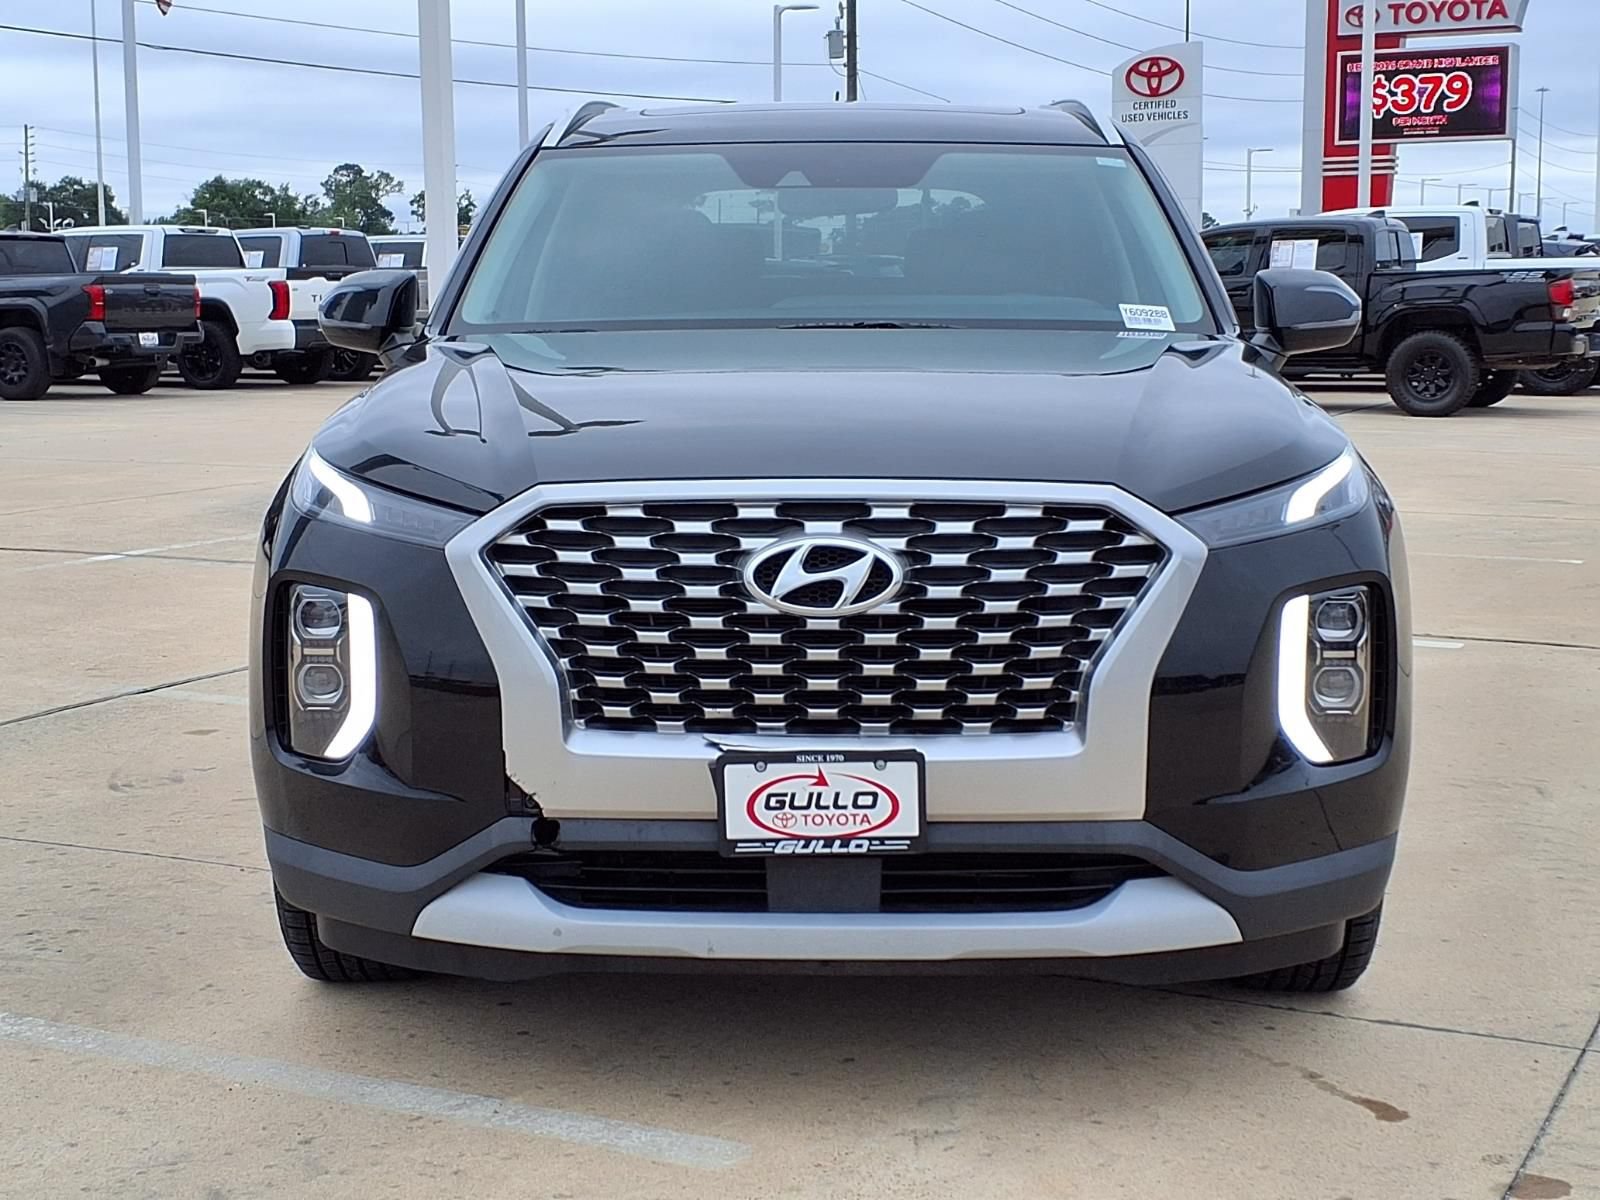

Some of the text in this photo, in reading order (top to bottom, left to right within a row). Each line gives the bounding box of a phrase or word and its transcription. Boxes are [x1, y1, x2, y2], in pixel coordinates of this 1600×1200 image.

[1388, 0, 1509, 25] TOYOTA
[1372, 71, 1473, 118] $379
[1132, 99, 1177, 111] CERTIFIED
[1121, 110, 1189, 123] USED VEHICLES
[796, 754, 845, 762] SINCE 1970
[764, 791, 879, 811] GULLO
[801, 813, 872, 827] TOYOTA
[774, 839, 870, 854] GULLO
